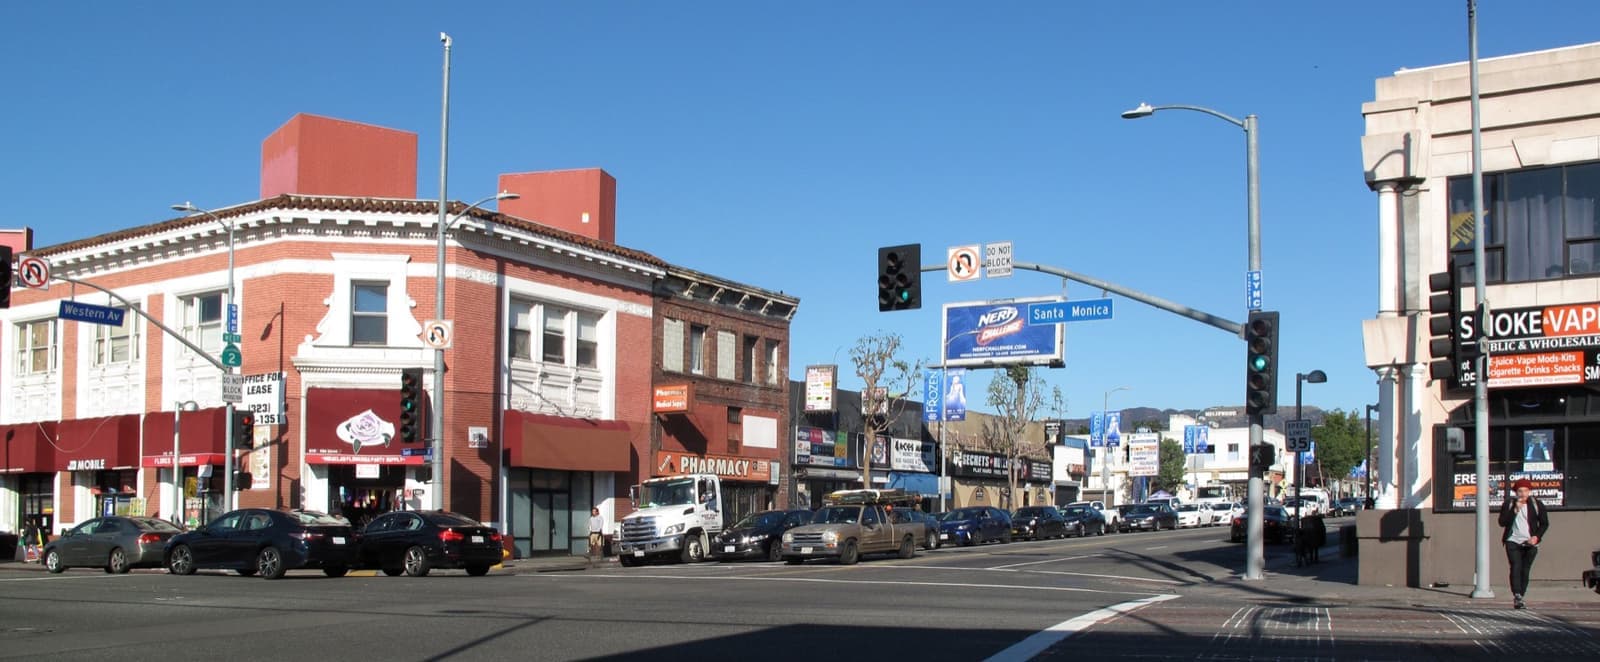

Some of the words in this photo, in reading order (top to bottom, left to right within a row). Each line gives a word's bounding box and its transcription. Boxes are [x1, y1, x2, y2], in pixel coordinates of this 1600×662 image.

[987, 247, 996, 256] DO
[998, 245, 1011, 254] NOT
[987, 258, 1011, 267] BLOCK
[1252, 272, 1261, 307] SYNC
[64, 303, 105, 319] Western
[107, 310, 121, 321] Av
[1034, 307, 1064, 320] Santa
[1072, 304, 1109, 317] Monica
[977, 309, 1017, 328] NERF
[1460, 311, 1542, 338] SOKE
[1488, 341, 1516, 352] BLIC
[228, 352, 236, 364] 2
[1517, 355, 1536, 366] Vape
[1537, 353, 1559, 363] Mods
[1561, 350, 1576, 361] Kits
[1525, 364, 1550, 374] Drinks
[1553, 362, 1581, 372] Snacks
[267, 371, 283, 382] FOR
[247, 384, 273, 395] LEASE
[656, 389, 686, 398] Pharmacy
[926, 370, 939, 413] FROZEN
[1288, 437, 1308, 449] 35
[78, 459, 105, 470] MOBILE
[680, 455, 750, 476] PHARMACY
[962, 453, 990, 467] SECRETS
[1454, 474, 1477, 485] FRE
[1531, 473, 1564, 481] PARKING
